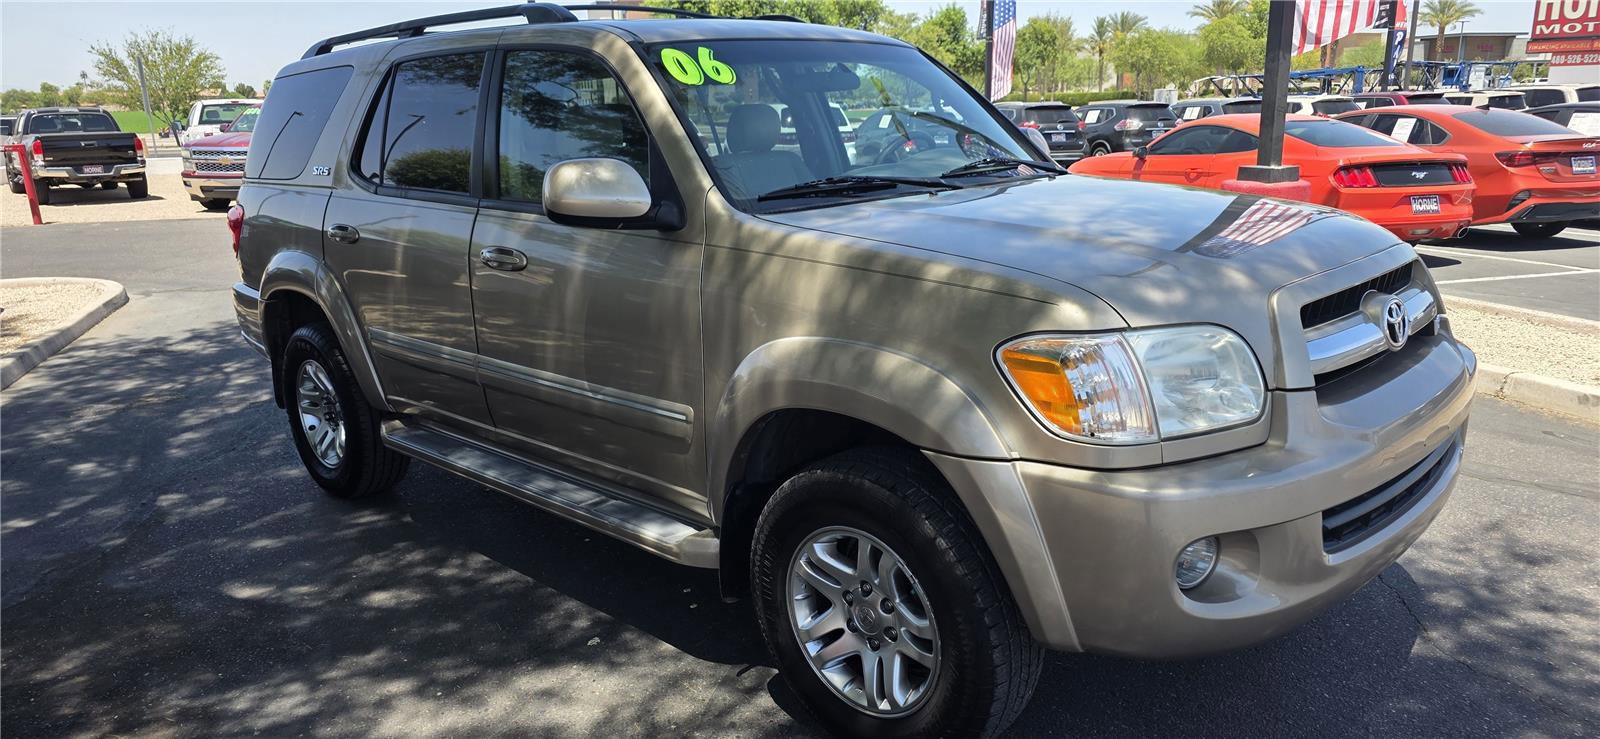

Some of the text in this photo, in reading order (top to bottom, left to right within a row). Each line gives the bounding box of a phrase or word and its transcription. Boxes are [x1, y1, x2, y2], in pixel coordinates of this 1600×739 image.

[1537, 0, 1599, 21] HO
[661, 46, 737, 86] 06
[1412, 198, 1439, 211] HORNE
